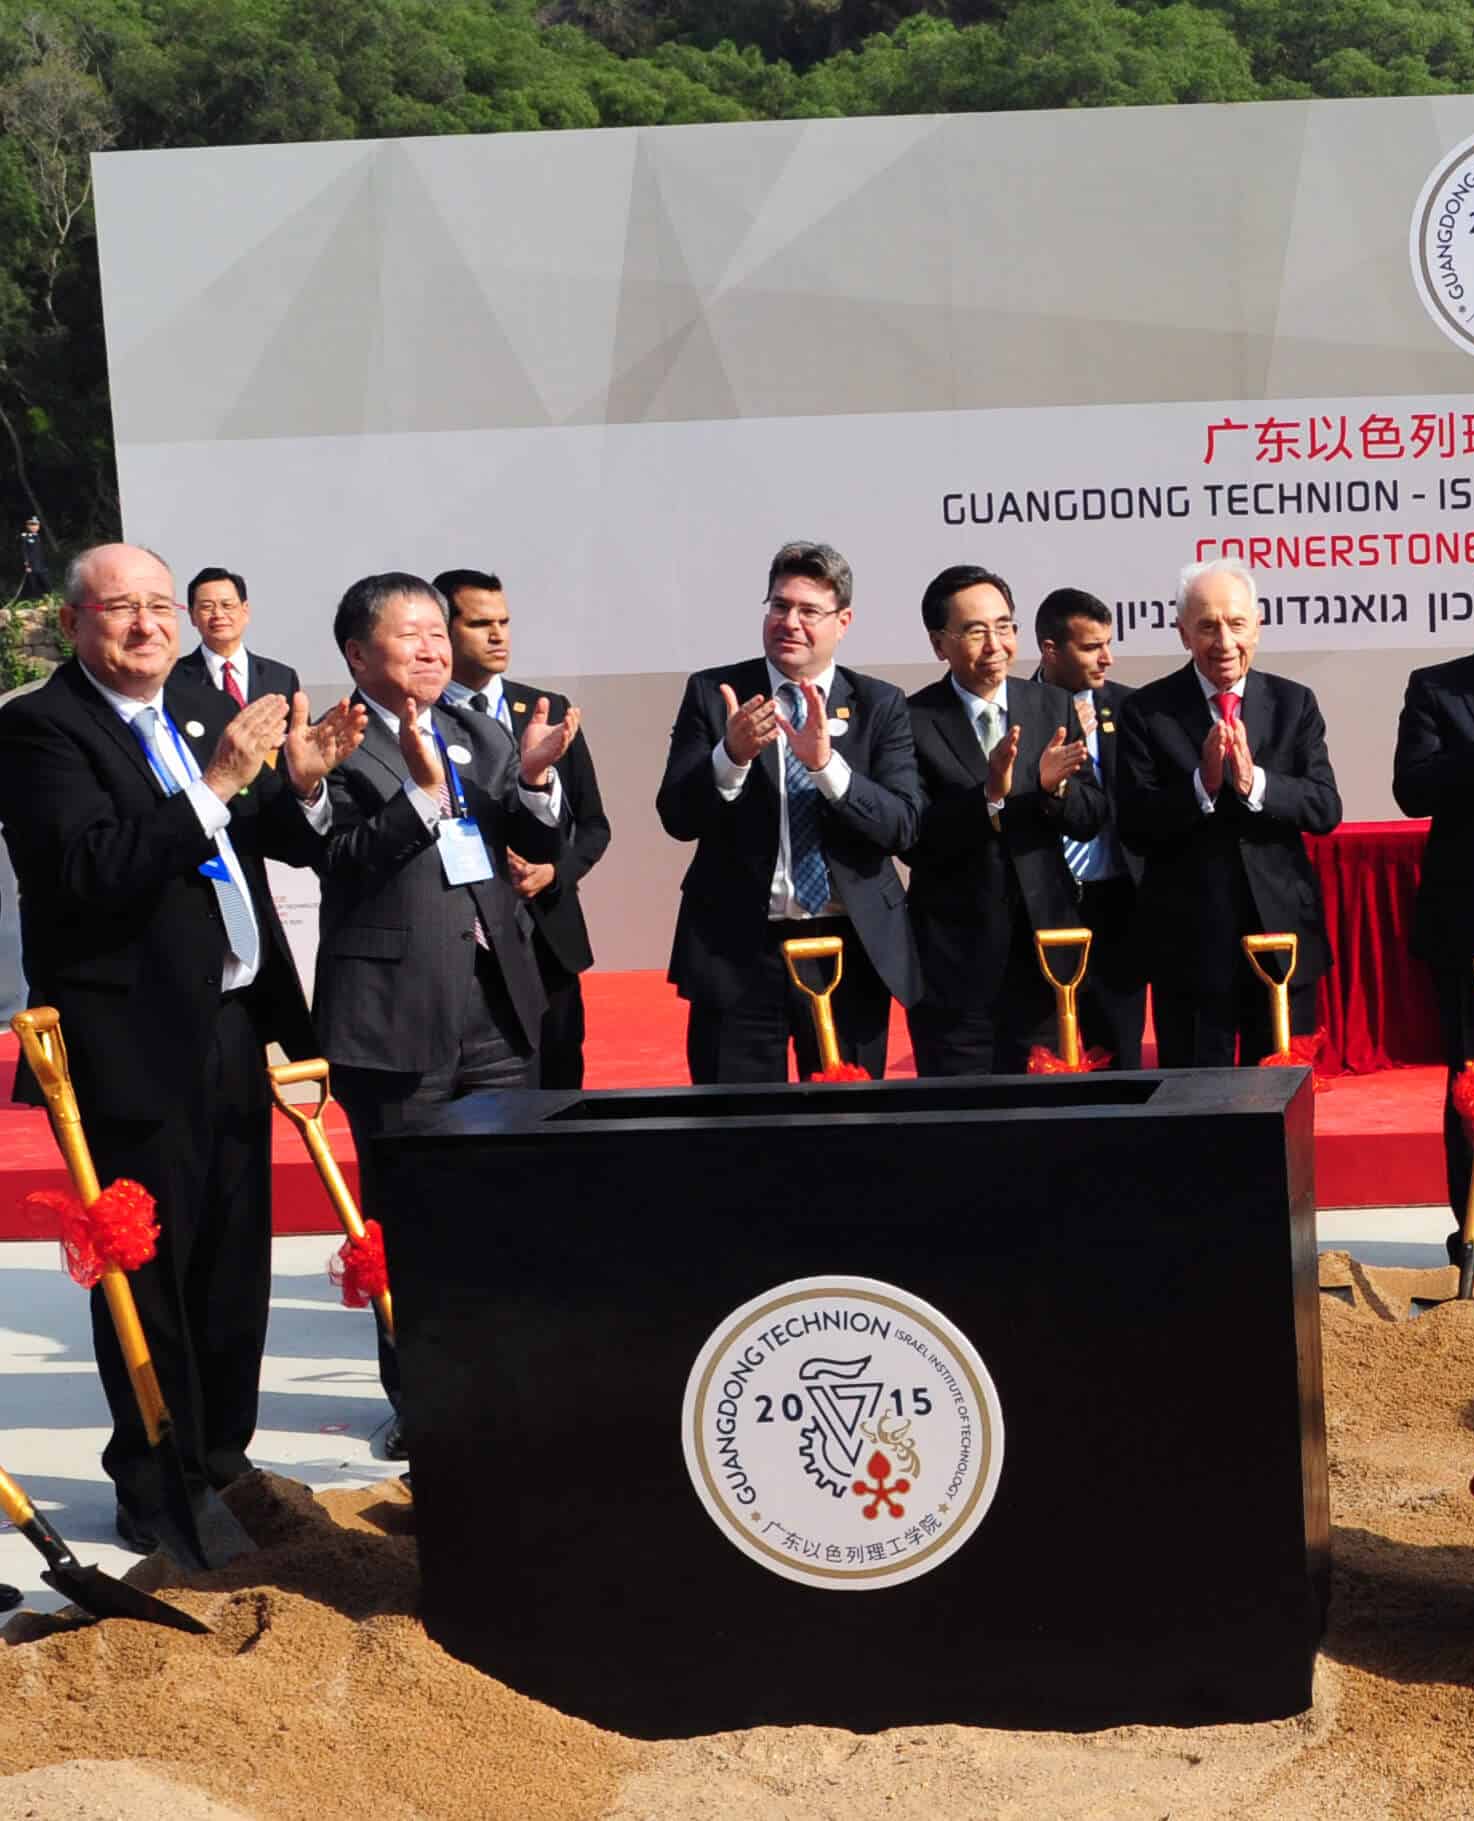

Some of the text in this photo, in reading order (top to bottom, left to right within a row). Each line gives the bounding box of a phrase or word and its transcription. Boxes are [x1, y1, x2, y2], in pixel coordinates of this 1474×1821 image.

[943, 485, 1190, 525] GUANGDONG
[1203, 479, 1399, 517] TECHNION
[1257, 593, 1408, 626] גואנגדונ
[716, 1310, 972, 1505] GUANGDONG TECHNION ISRAEL INSTITUTE OF TECHNOLOGY
[761, 1512, 943, 1564] 广东以色列理工学院
